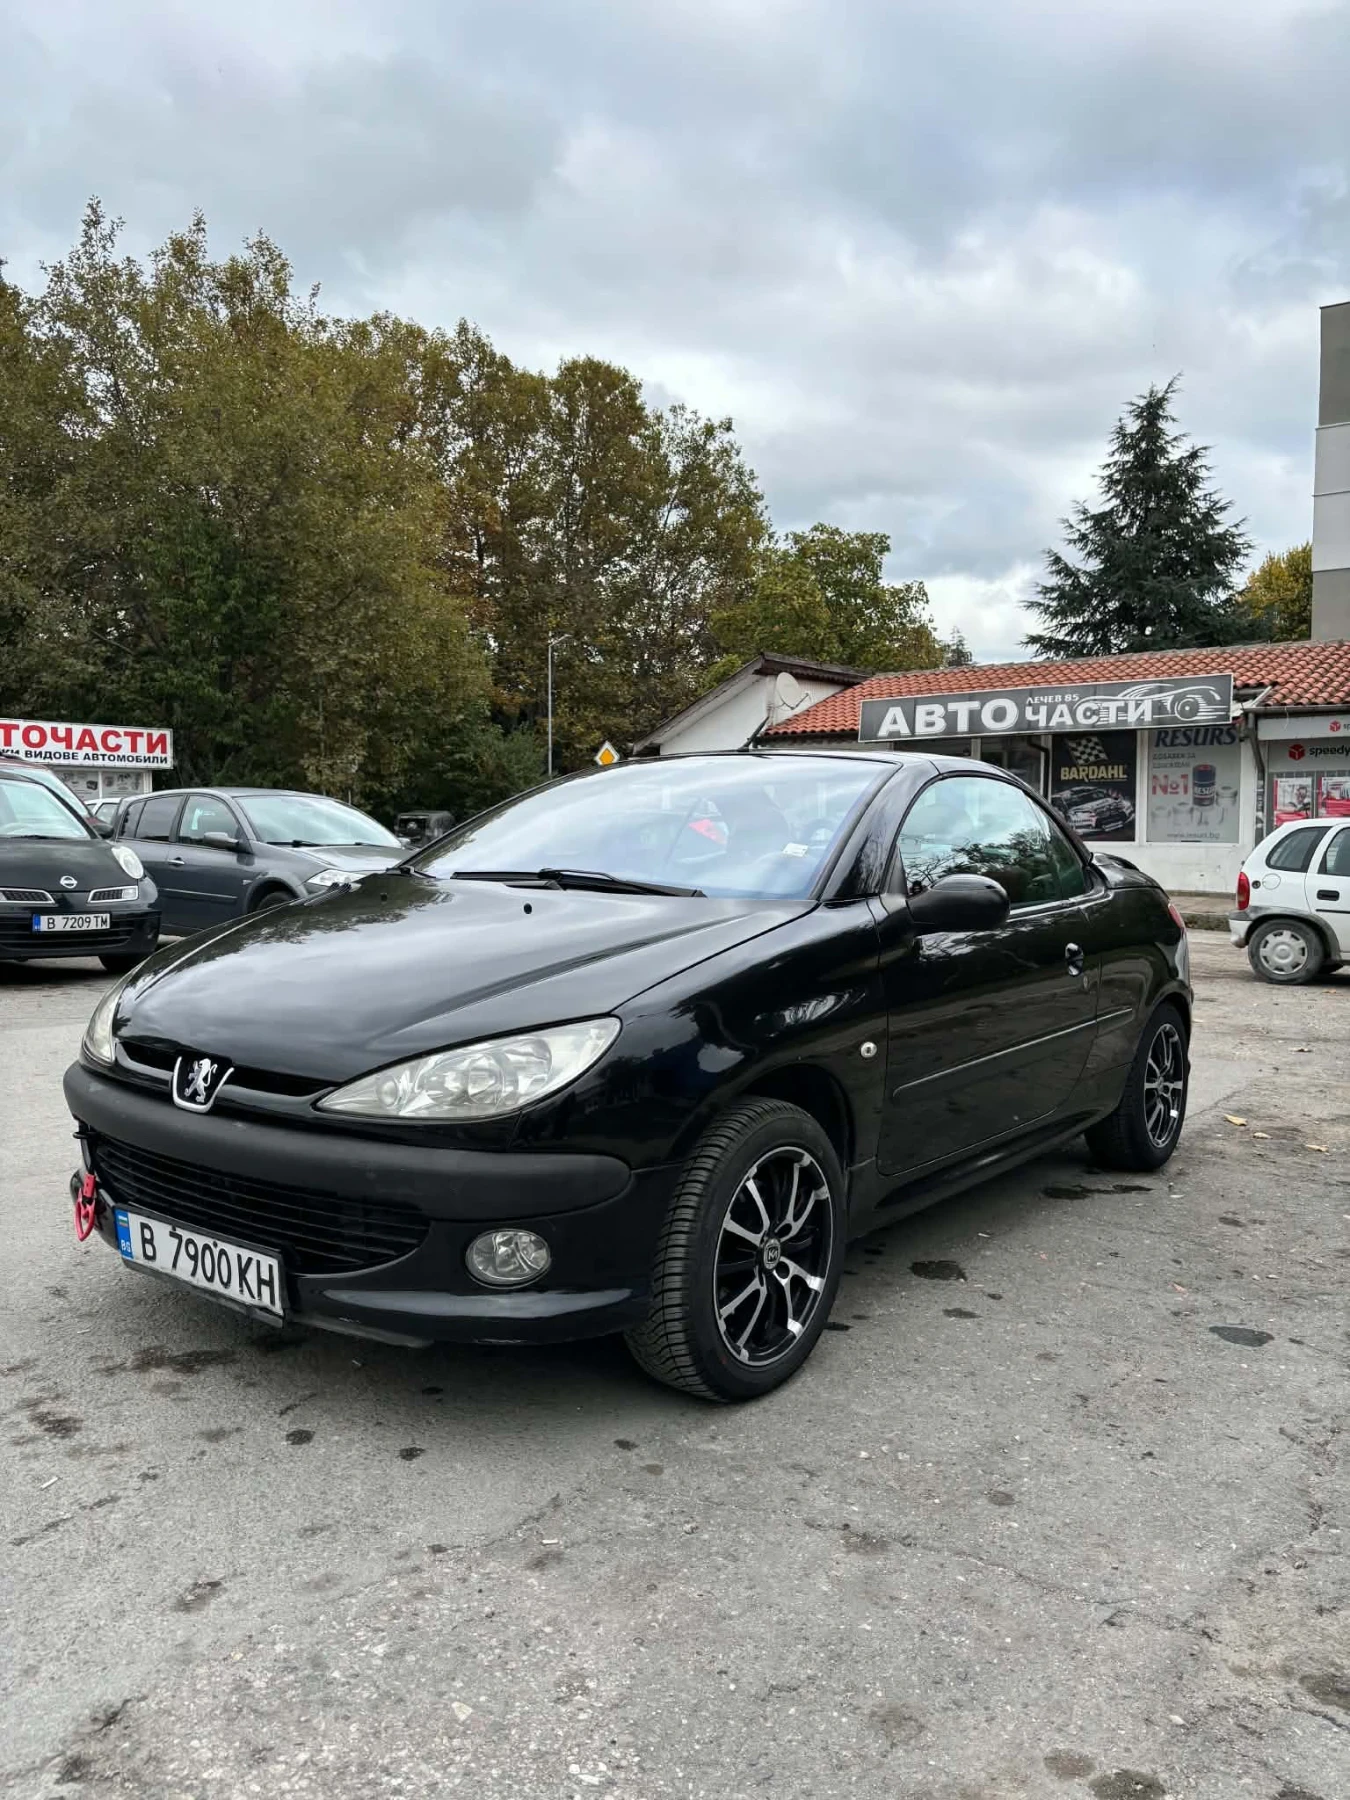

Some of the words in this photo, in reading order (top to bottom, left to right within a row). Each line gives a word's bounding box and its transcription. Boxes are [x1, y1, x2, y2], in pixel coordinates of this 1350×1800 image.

[1026, 695, 1063, 705] ЛЕЧЕВ
[1064, 693, 1080, 702] 85
[876, 698, 1019, 738] АВТО
[1024, 700, 1153, 727] ЧАСТИ
[1154, 727, 1237, 748] RESURS
[25, 750, 79, 760] ВИДОВЕ
[83, 752, 168, 764] АВТОМОБИЛИ
[1309, 744, 1350, 757] speedy
[1060, 765, 1128, 783] BARDAHL
[62, 916, 91, 929] 7209
[94, 915, 107, 927] TM
[140, 1222, 156, 1261] B
[169, 1230, 231, 1289] 7900
[237, 1253, 276, 1306] KH
